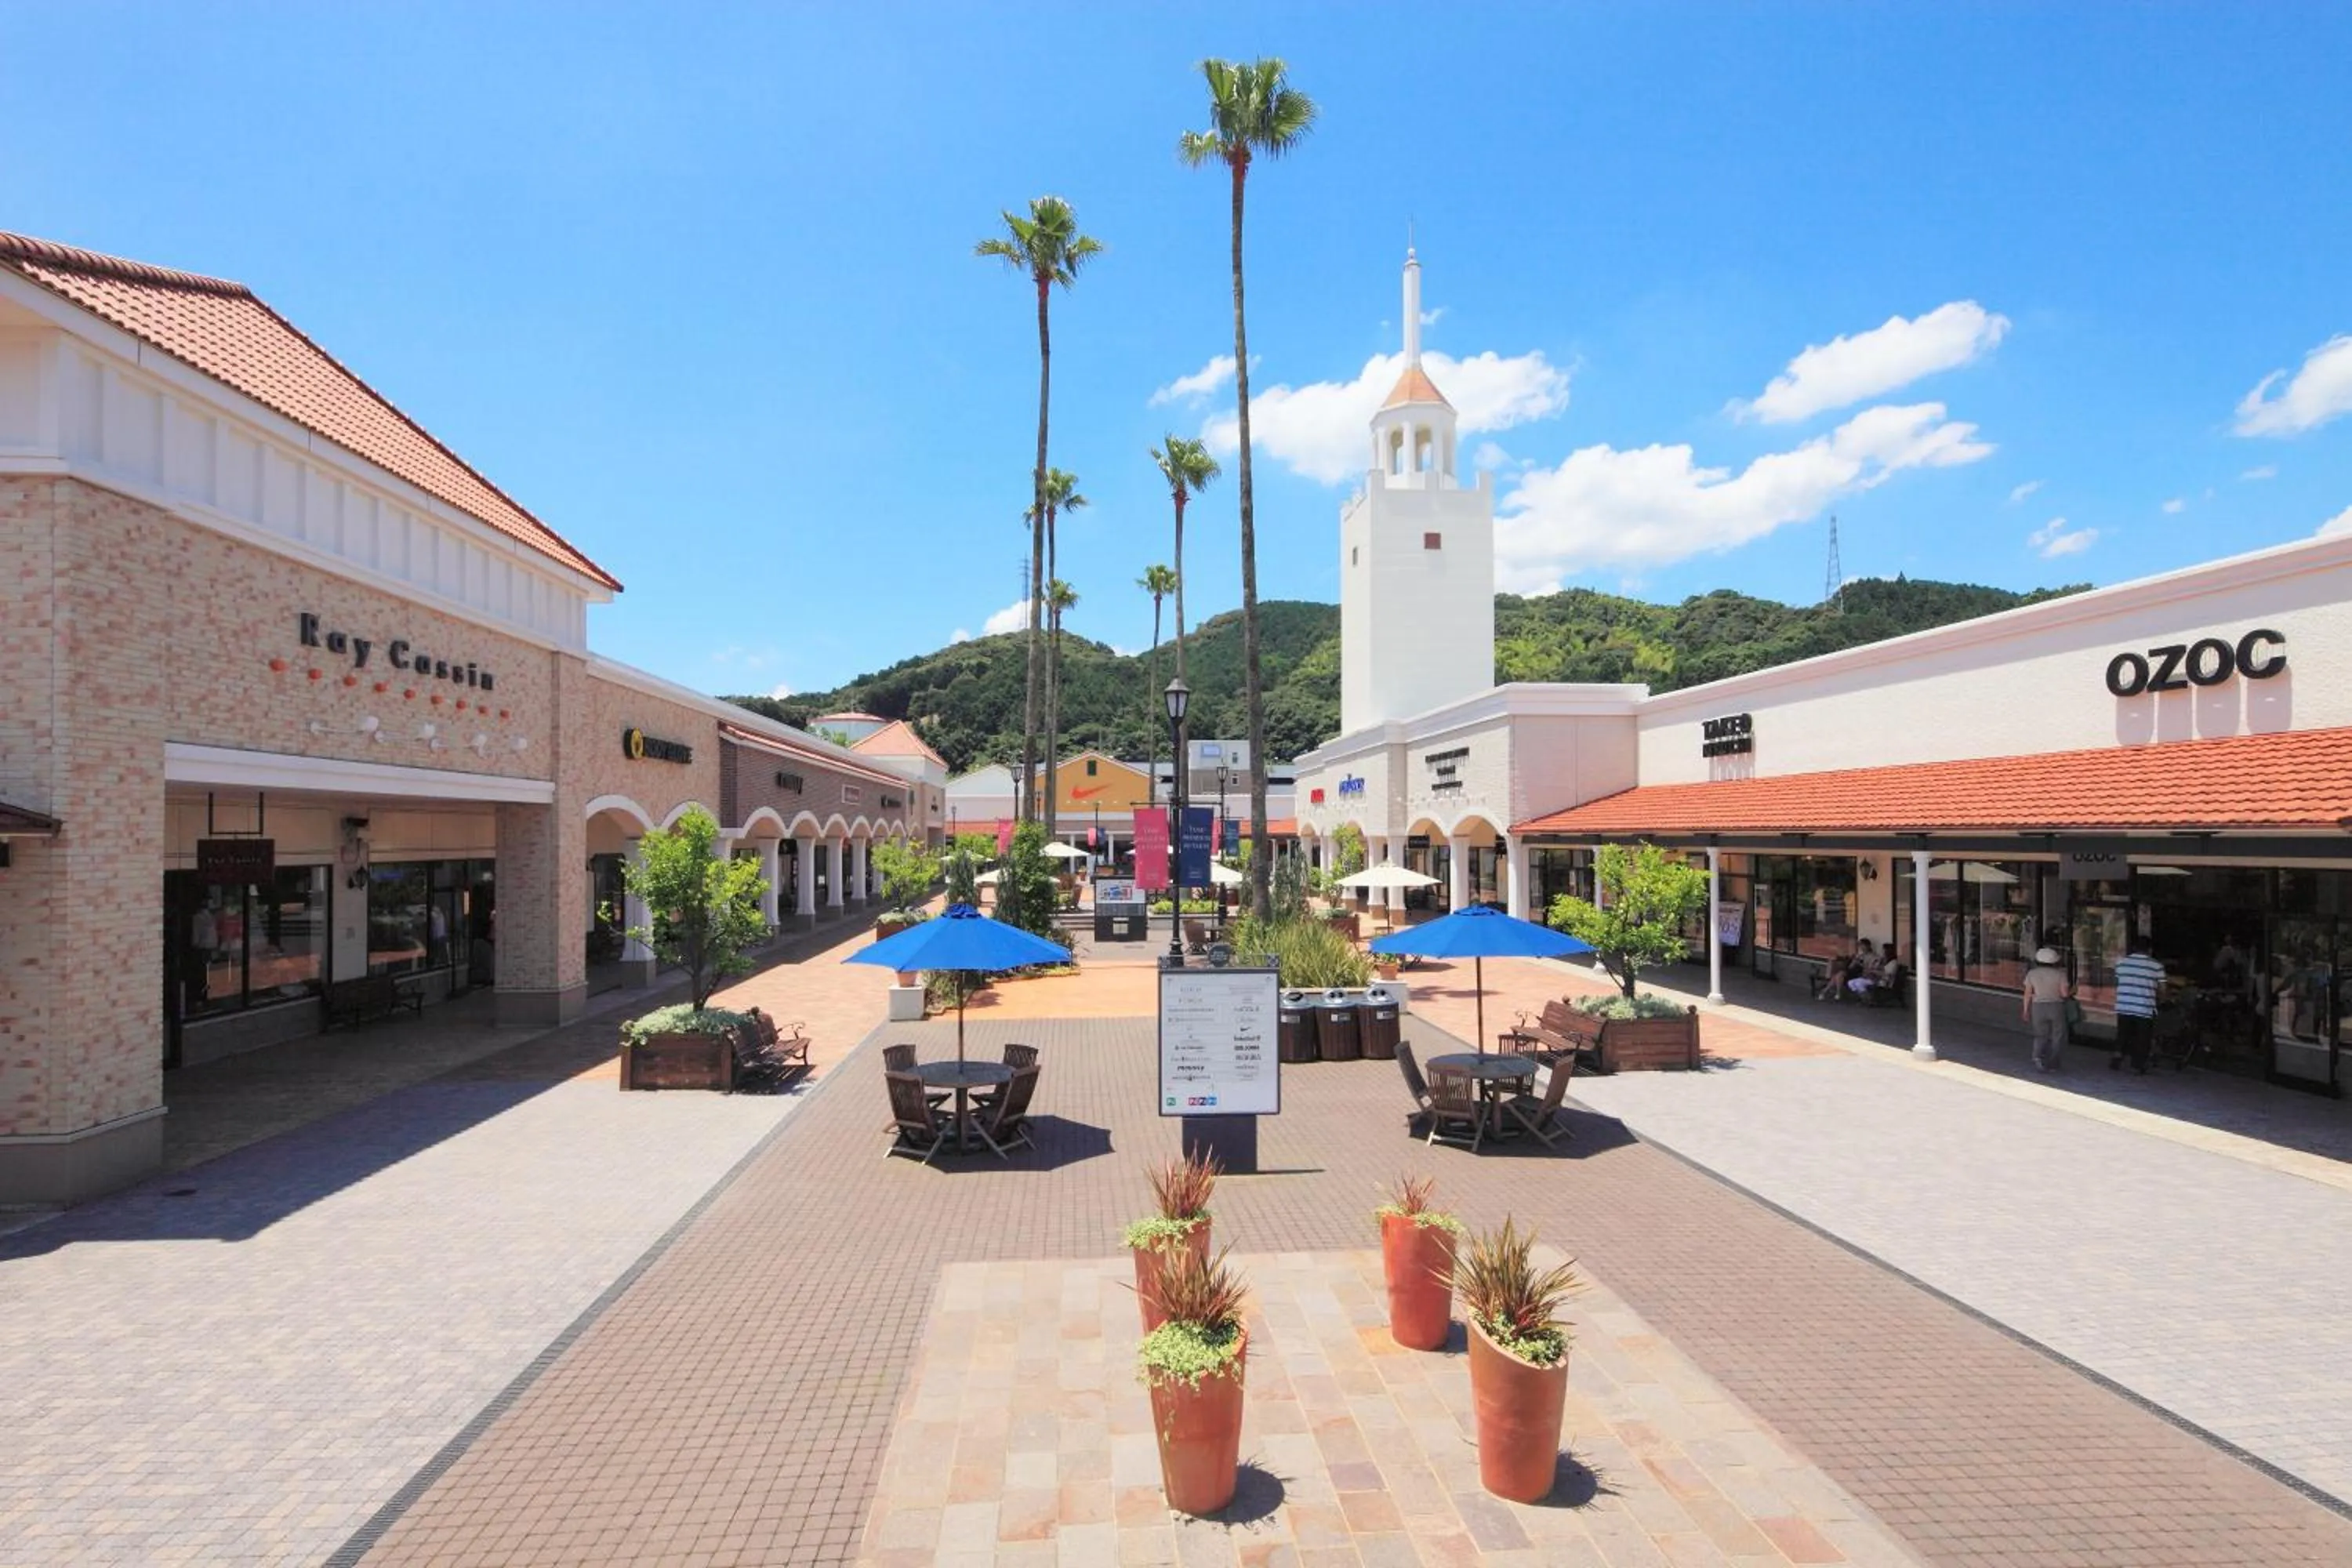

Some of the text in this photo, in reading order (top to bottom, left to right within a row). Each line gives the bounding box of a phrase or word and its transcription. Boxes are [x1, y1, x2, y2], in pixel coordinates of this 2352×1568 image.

[300, 612, 493, 690] Ray Cassin
[2106, 629, 2287, 696] OZOC
